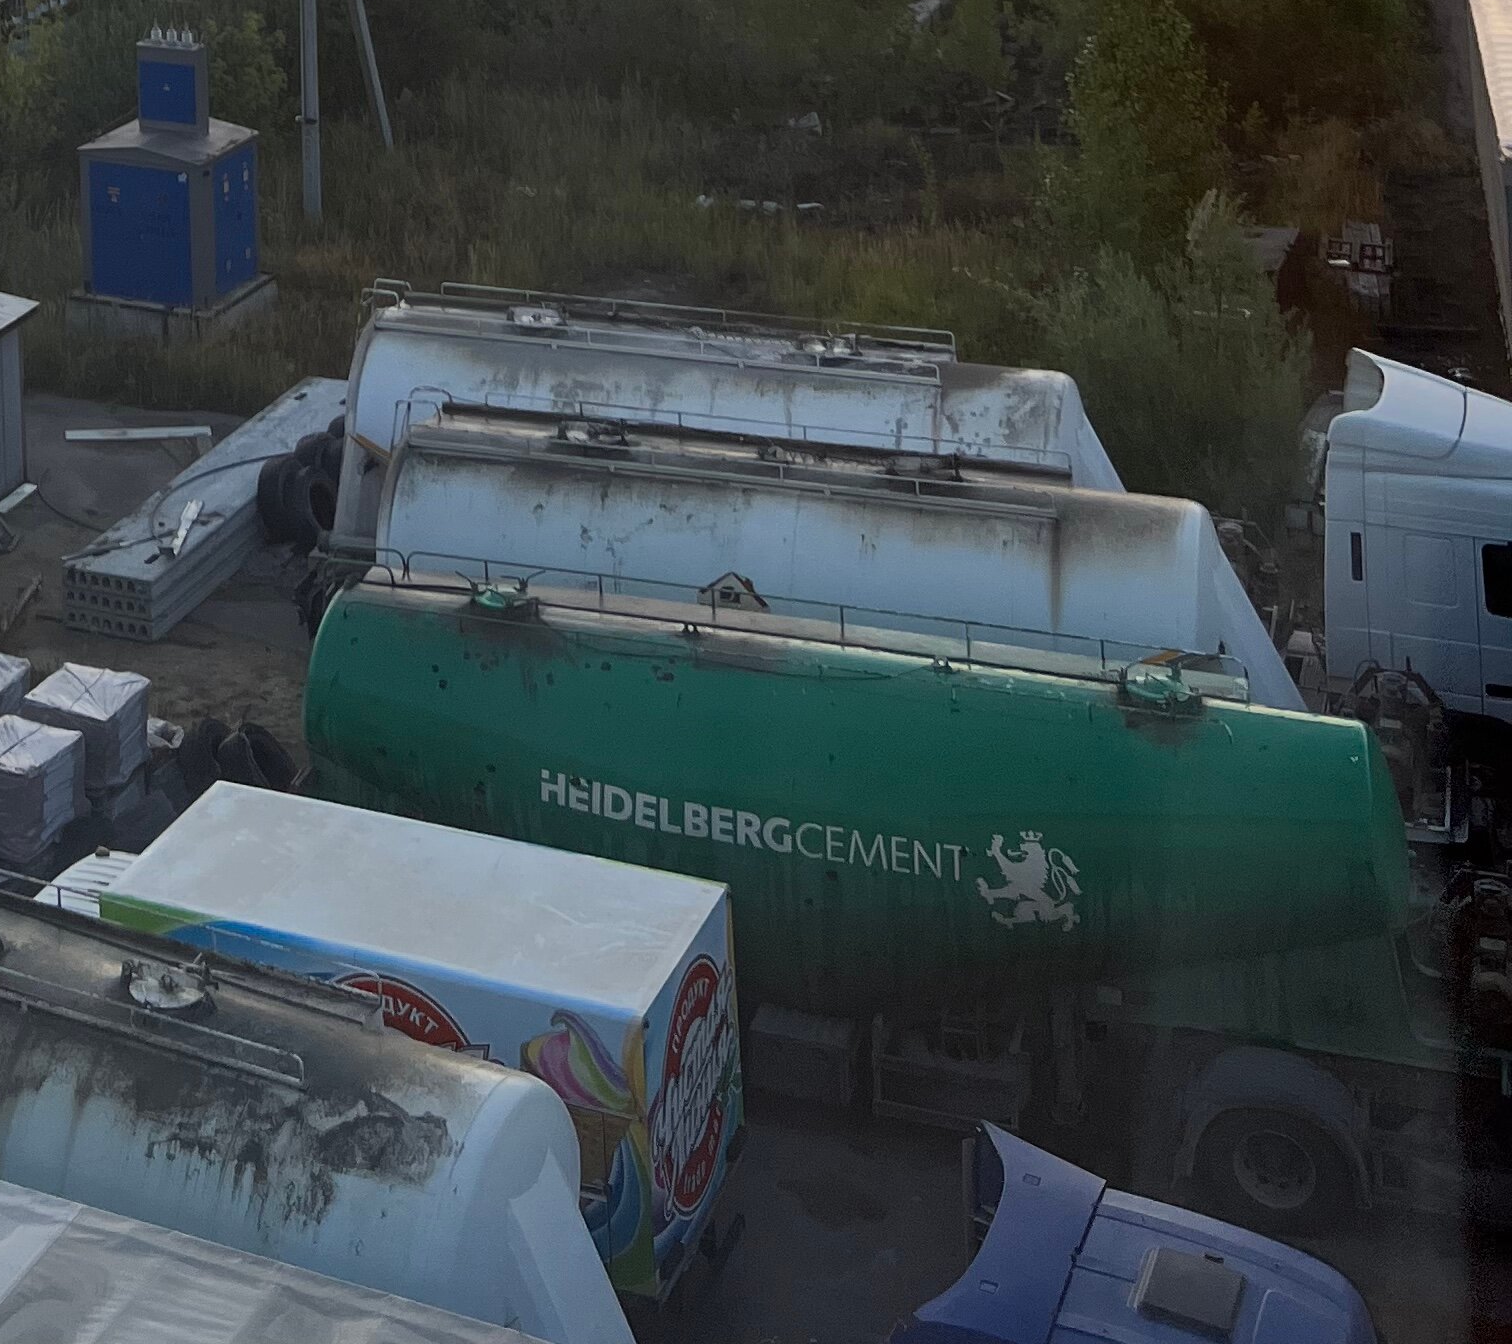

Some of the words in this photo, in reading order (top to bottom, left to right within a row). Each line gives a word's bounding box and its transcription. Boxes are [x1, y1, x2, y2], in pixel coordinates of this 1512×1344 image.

[540, 768, 963, 882] HEIDELBERGCEMENT
[381, 994, 439, 1035] ДУКТ
[671, 977, 710, 1054] ПРОДУКТ
